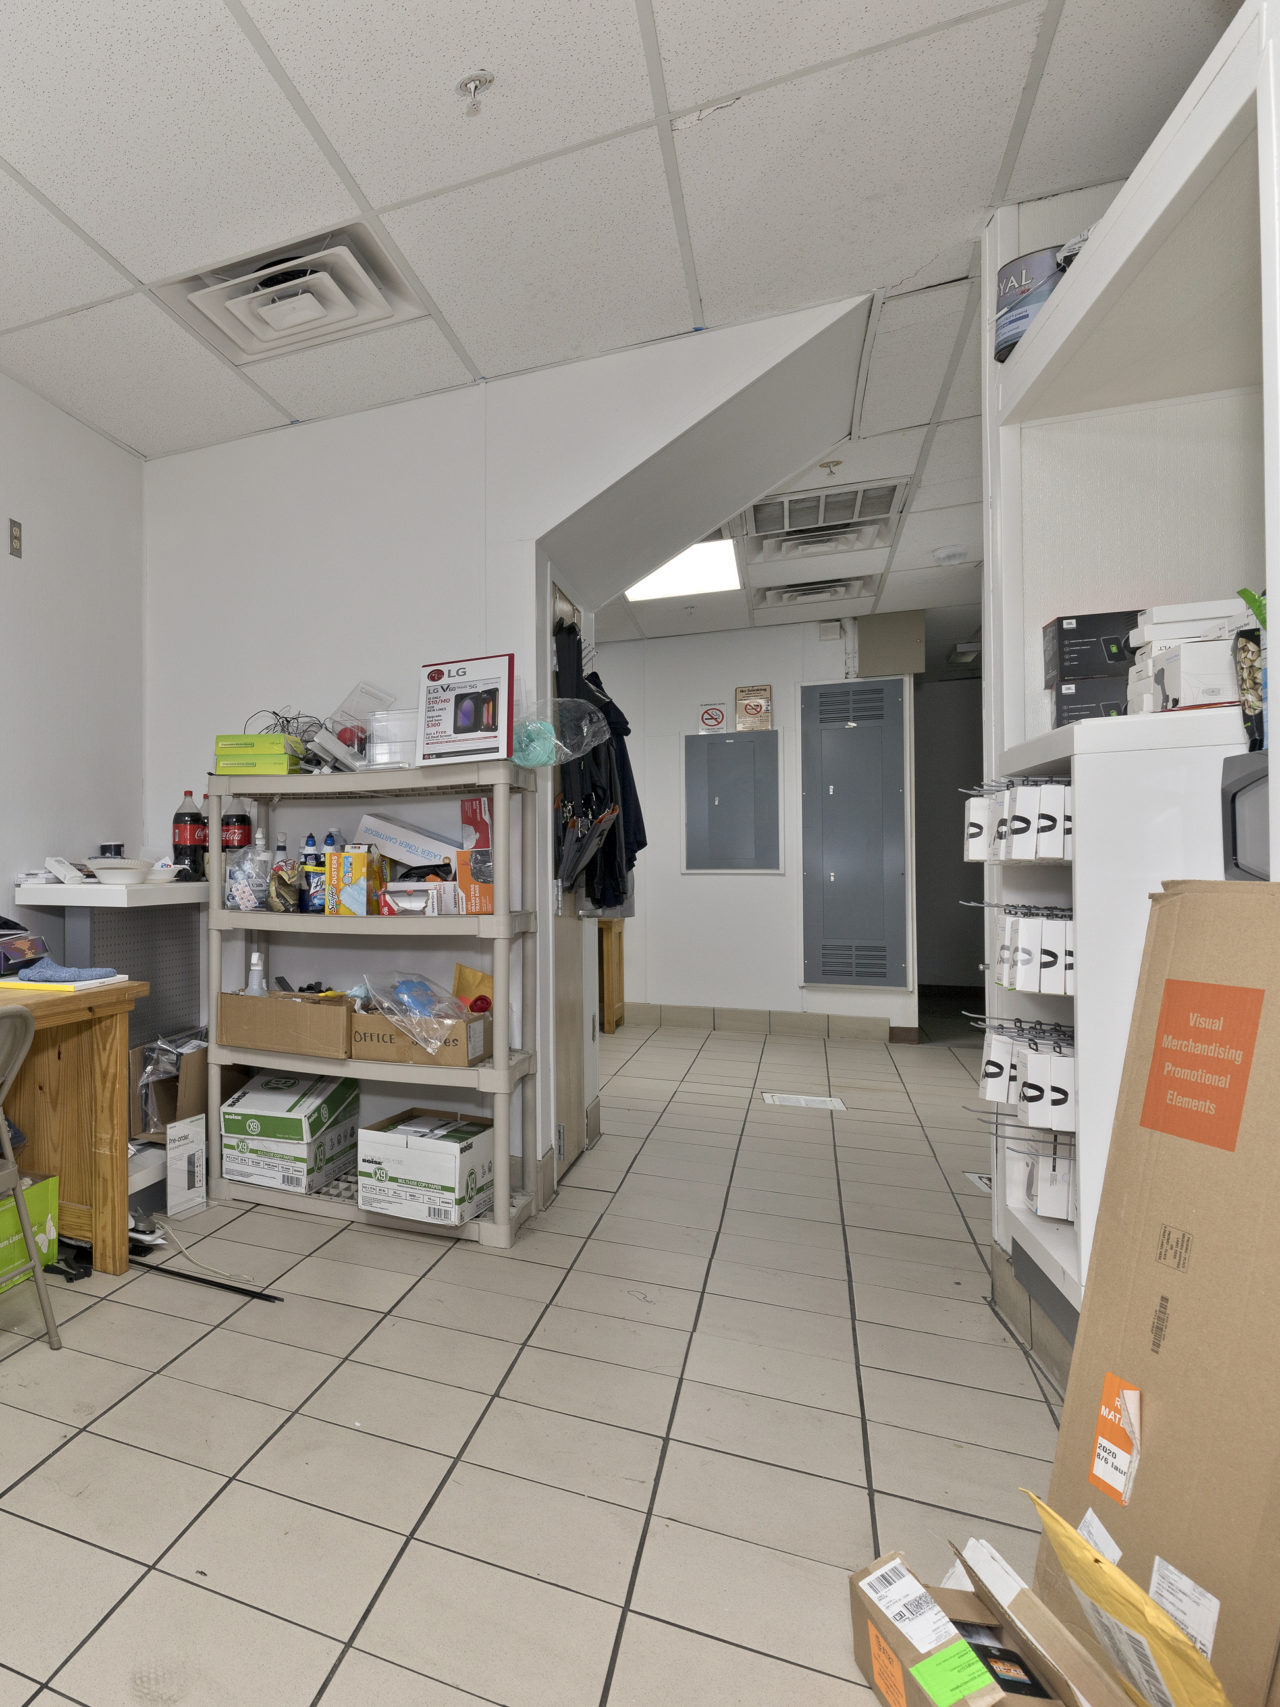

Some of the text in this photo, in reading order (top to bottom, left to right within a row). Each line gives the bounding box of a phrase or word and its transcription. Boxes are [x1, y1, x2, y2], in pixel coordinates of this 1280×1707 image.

[447, 667, 467, 679] LG
[428, 687, 439, 695] LG
[1189, 1012, 1223, 1032] Visual
[353, 1030, 396, 1044] OFFICE
[1161, 1034, 1243, 1064] Merchandising
[1163, 1062, 1231, 1089] Promotional
[1166, 1090, 1217, 1116] Elements
[248, 1121, 259, 1132] X9
[237, 1142, 248, 1153] X9
[375, 1169, 386, 1181] X9
[417, 1180, 428, 1188] COPY
[428, 1182, 442, 1190] PAPER
[1098, 1442, 1117, 1459] 2020
[1096, 1452, 1109, 1465] 8/6
